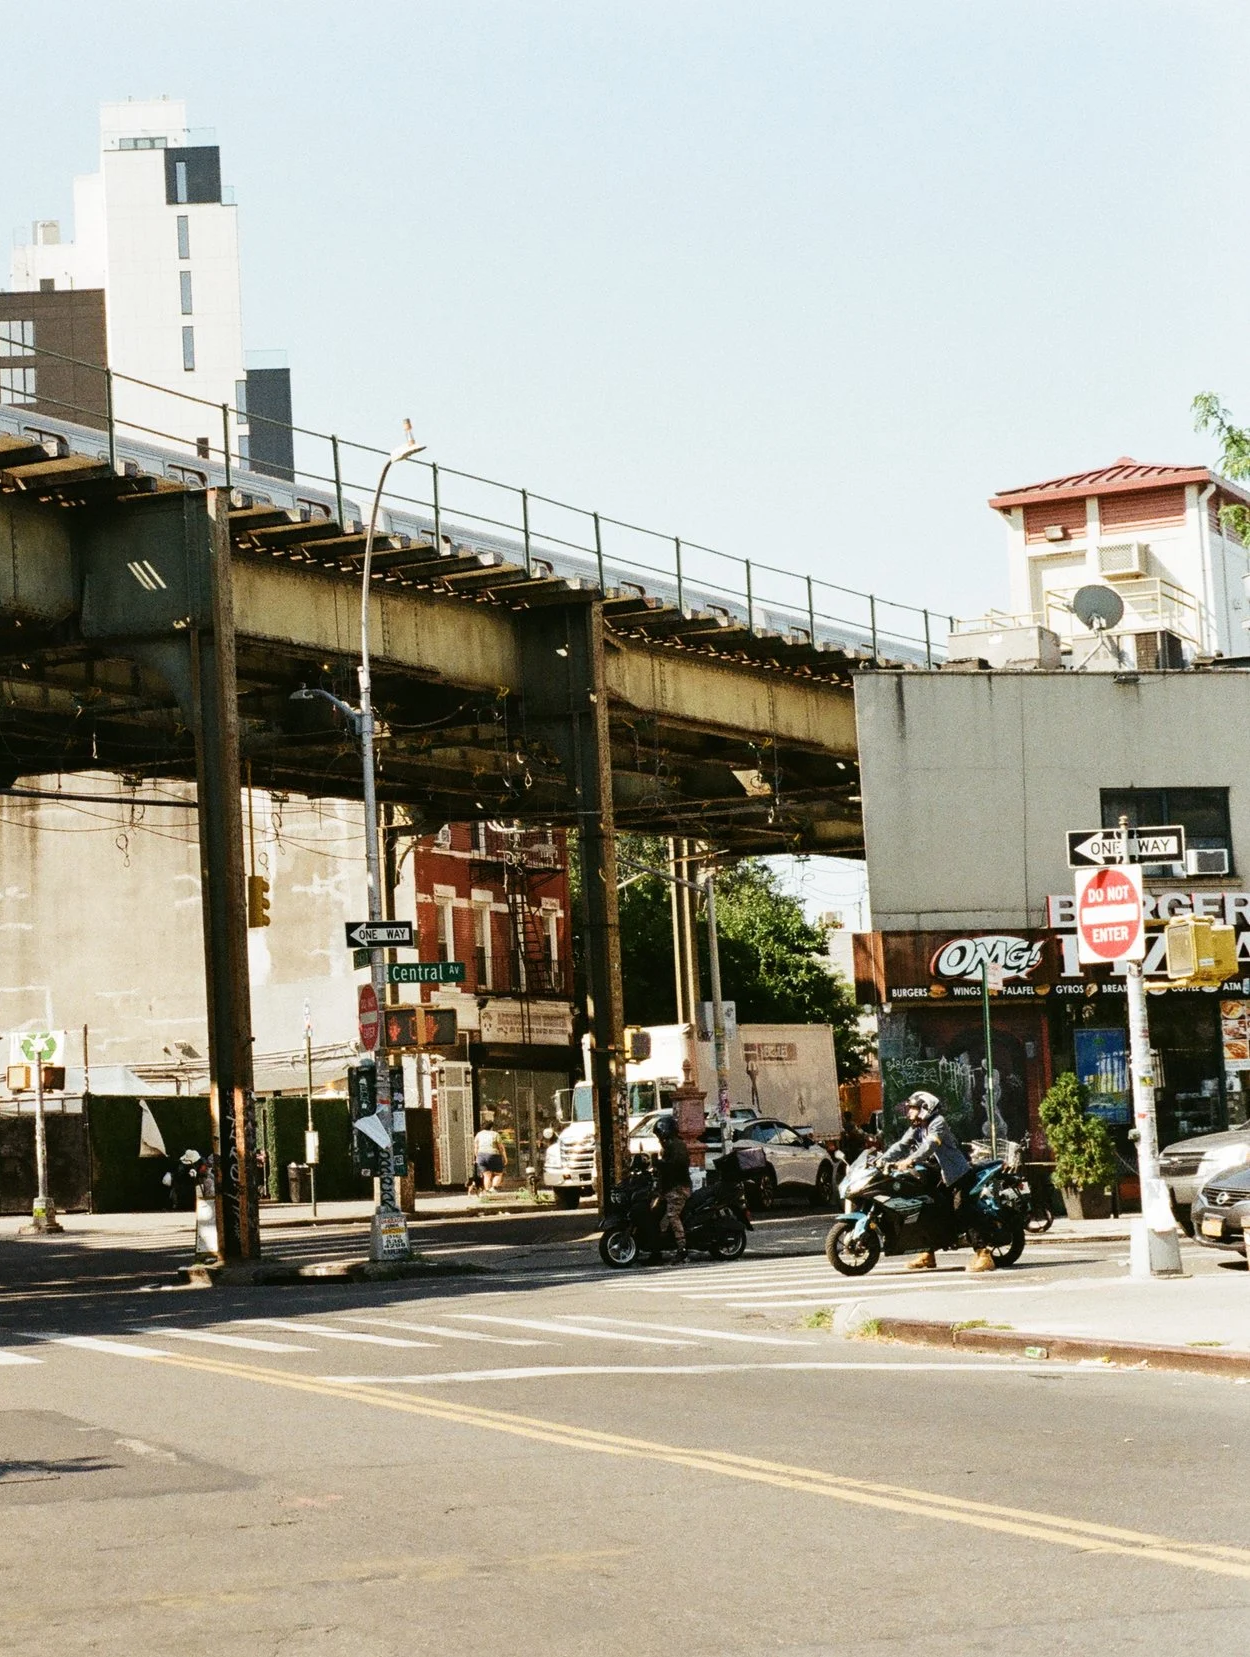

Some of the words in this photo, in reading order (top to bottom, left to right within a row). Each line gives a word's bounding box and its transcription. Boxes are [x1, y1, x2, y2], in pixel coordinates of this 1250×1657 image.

[1090, 841, 1122, 855] ONE
[1137, 838, 1170, 853] WAY
[1088, 888, 1103, 903] DO
[1107, 885, 1129, 901] NOT
[1050, 893, 1250, 928] BGER
[359, 929, 378, 940] ONE
[386, 929, 406, 939] WAY
[1092, 926, 1129, 943] ENTER
[938, 938, 1046, 976] OMG!
[392, 964, 443, 981] Central
[449, 965, 459, 975] Av
[891, 988, 928, 998] BURGERS
[953, 986, 982, 996] WINGS
[1002, 985, 1035, 995] FALAFEL
[1055, 985, 1084, 994] GYROS
[1222, 982, 1242, 991] ATM
